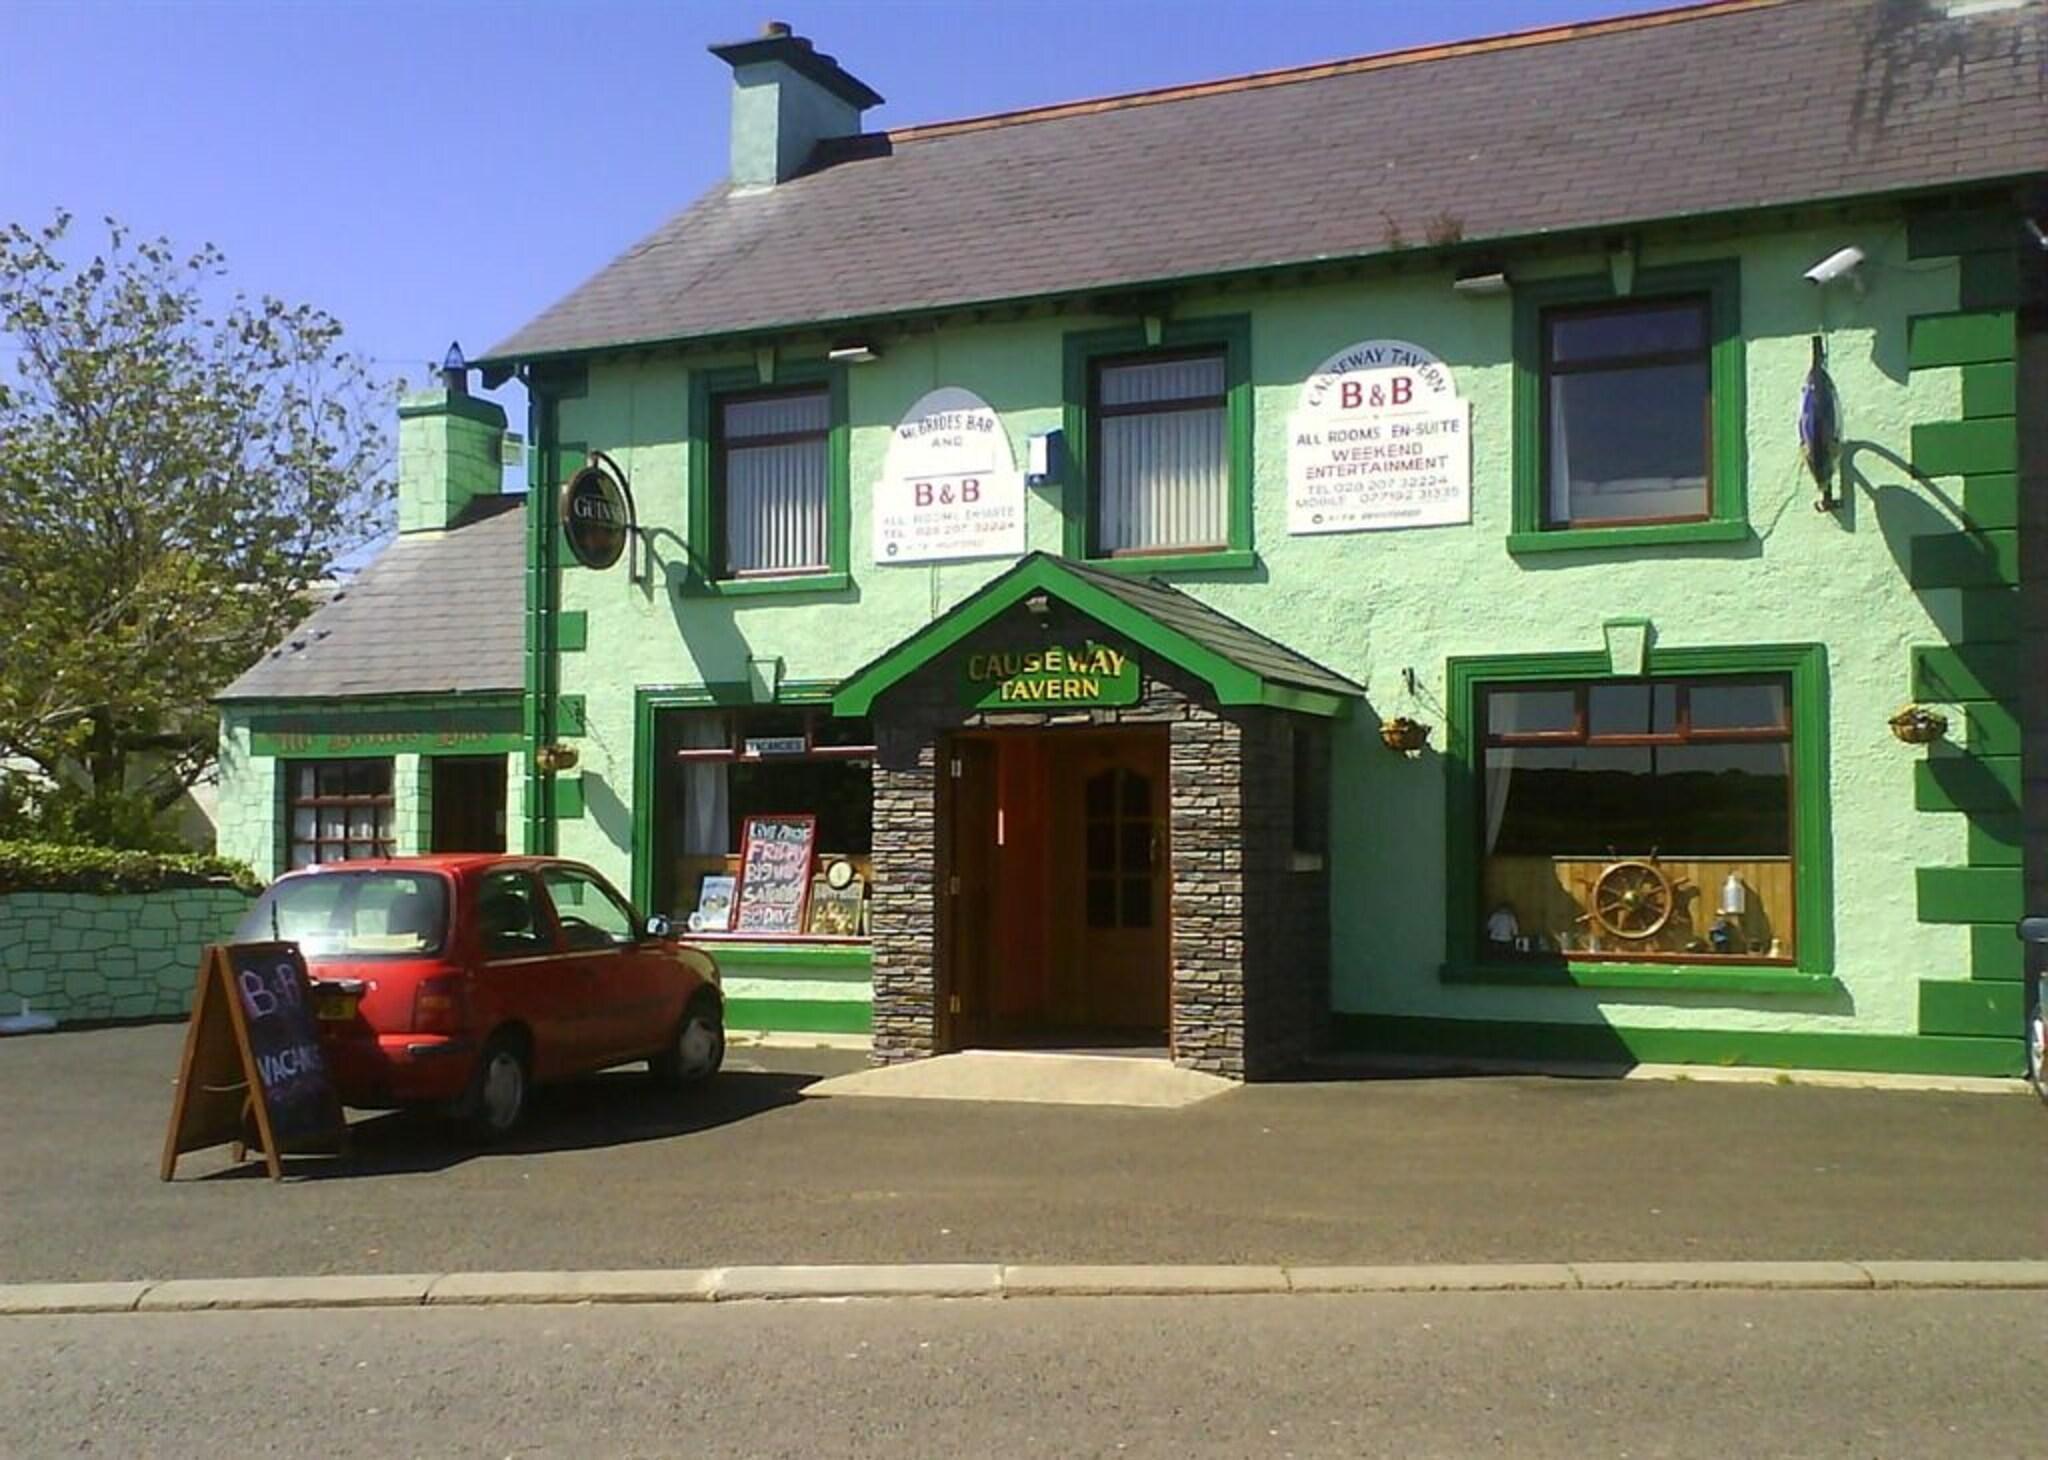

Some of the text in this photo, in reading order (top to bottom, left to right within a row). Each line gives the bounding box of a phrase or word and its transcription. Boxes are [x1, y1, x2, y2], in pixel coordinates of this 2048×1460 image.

[1391, 347, 1446, 394] TAVERN
[967, 414, 994, 432] BAR
[931, 436, 963, 448] AND
[1297, 433, 1321, 446] ALL
[1328, 427, 1381, 443] ROOMS
[1332, 443, 1423, 462] WEEKEND
[1306, 456, 1449, 480] ENTERTAINMENT
[968, 649, 1125, 681] CAUSEWAY
[1001, 678, 1099, 701] TAVERN
